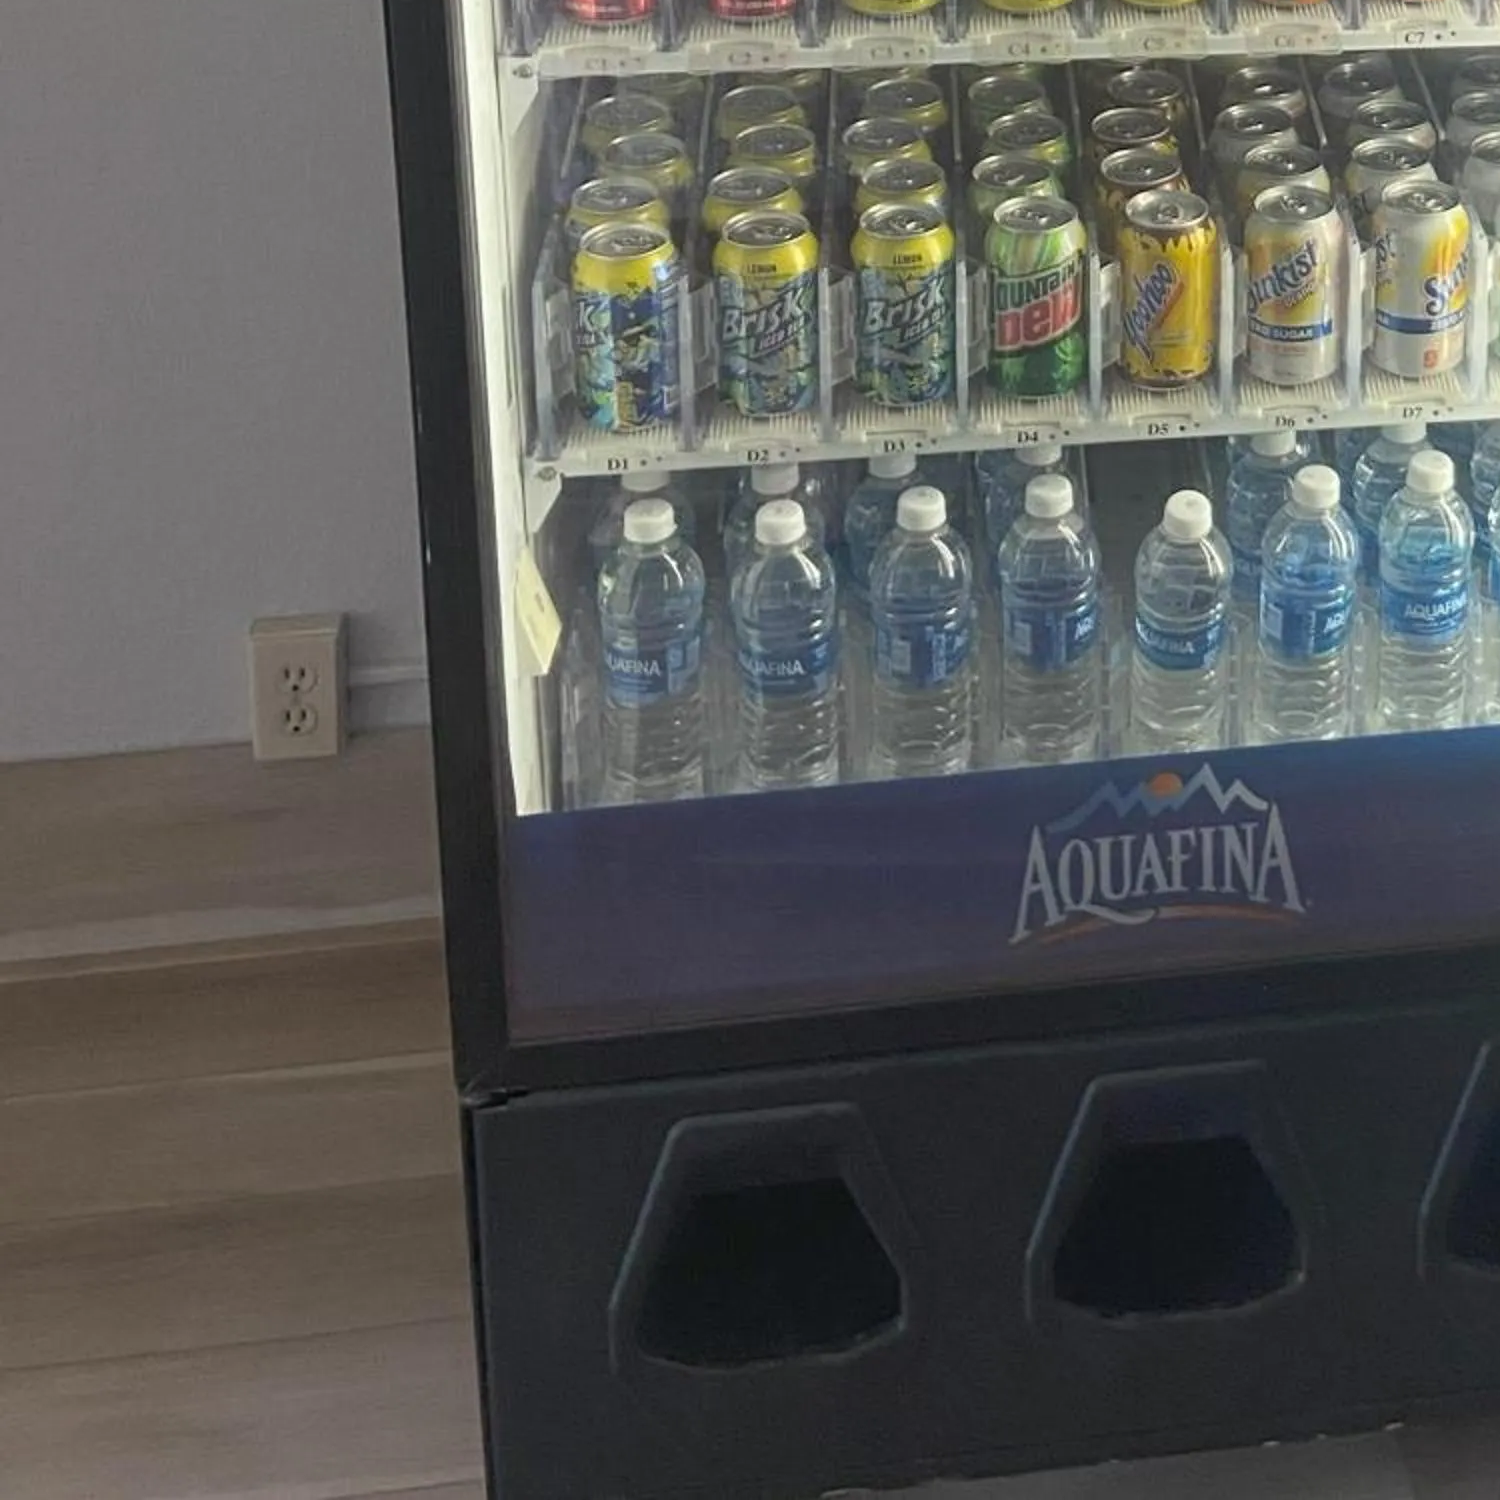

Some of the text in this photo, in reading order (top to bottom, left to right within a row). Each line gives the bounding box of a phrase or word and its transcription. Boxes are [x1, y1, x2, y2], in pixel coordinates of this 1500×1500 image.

[1405, 32, 1425, 45] C7
[1248, 238, 1319, 311] unkist
[1402, 406, 1423, 419] D7
[1274, 414, 1295, 427] D6
[1147, 423, 1169, 435] D5
[1017, 431, 1039, 444] D4
[747, 450, 769, 462] D2
[607, 458, 628, 471] D1
[1008, 802, 1306, 945] AQUAFINA
